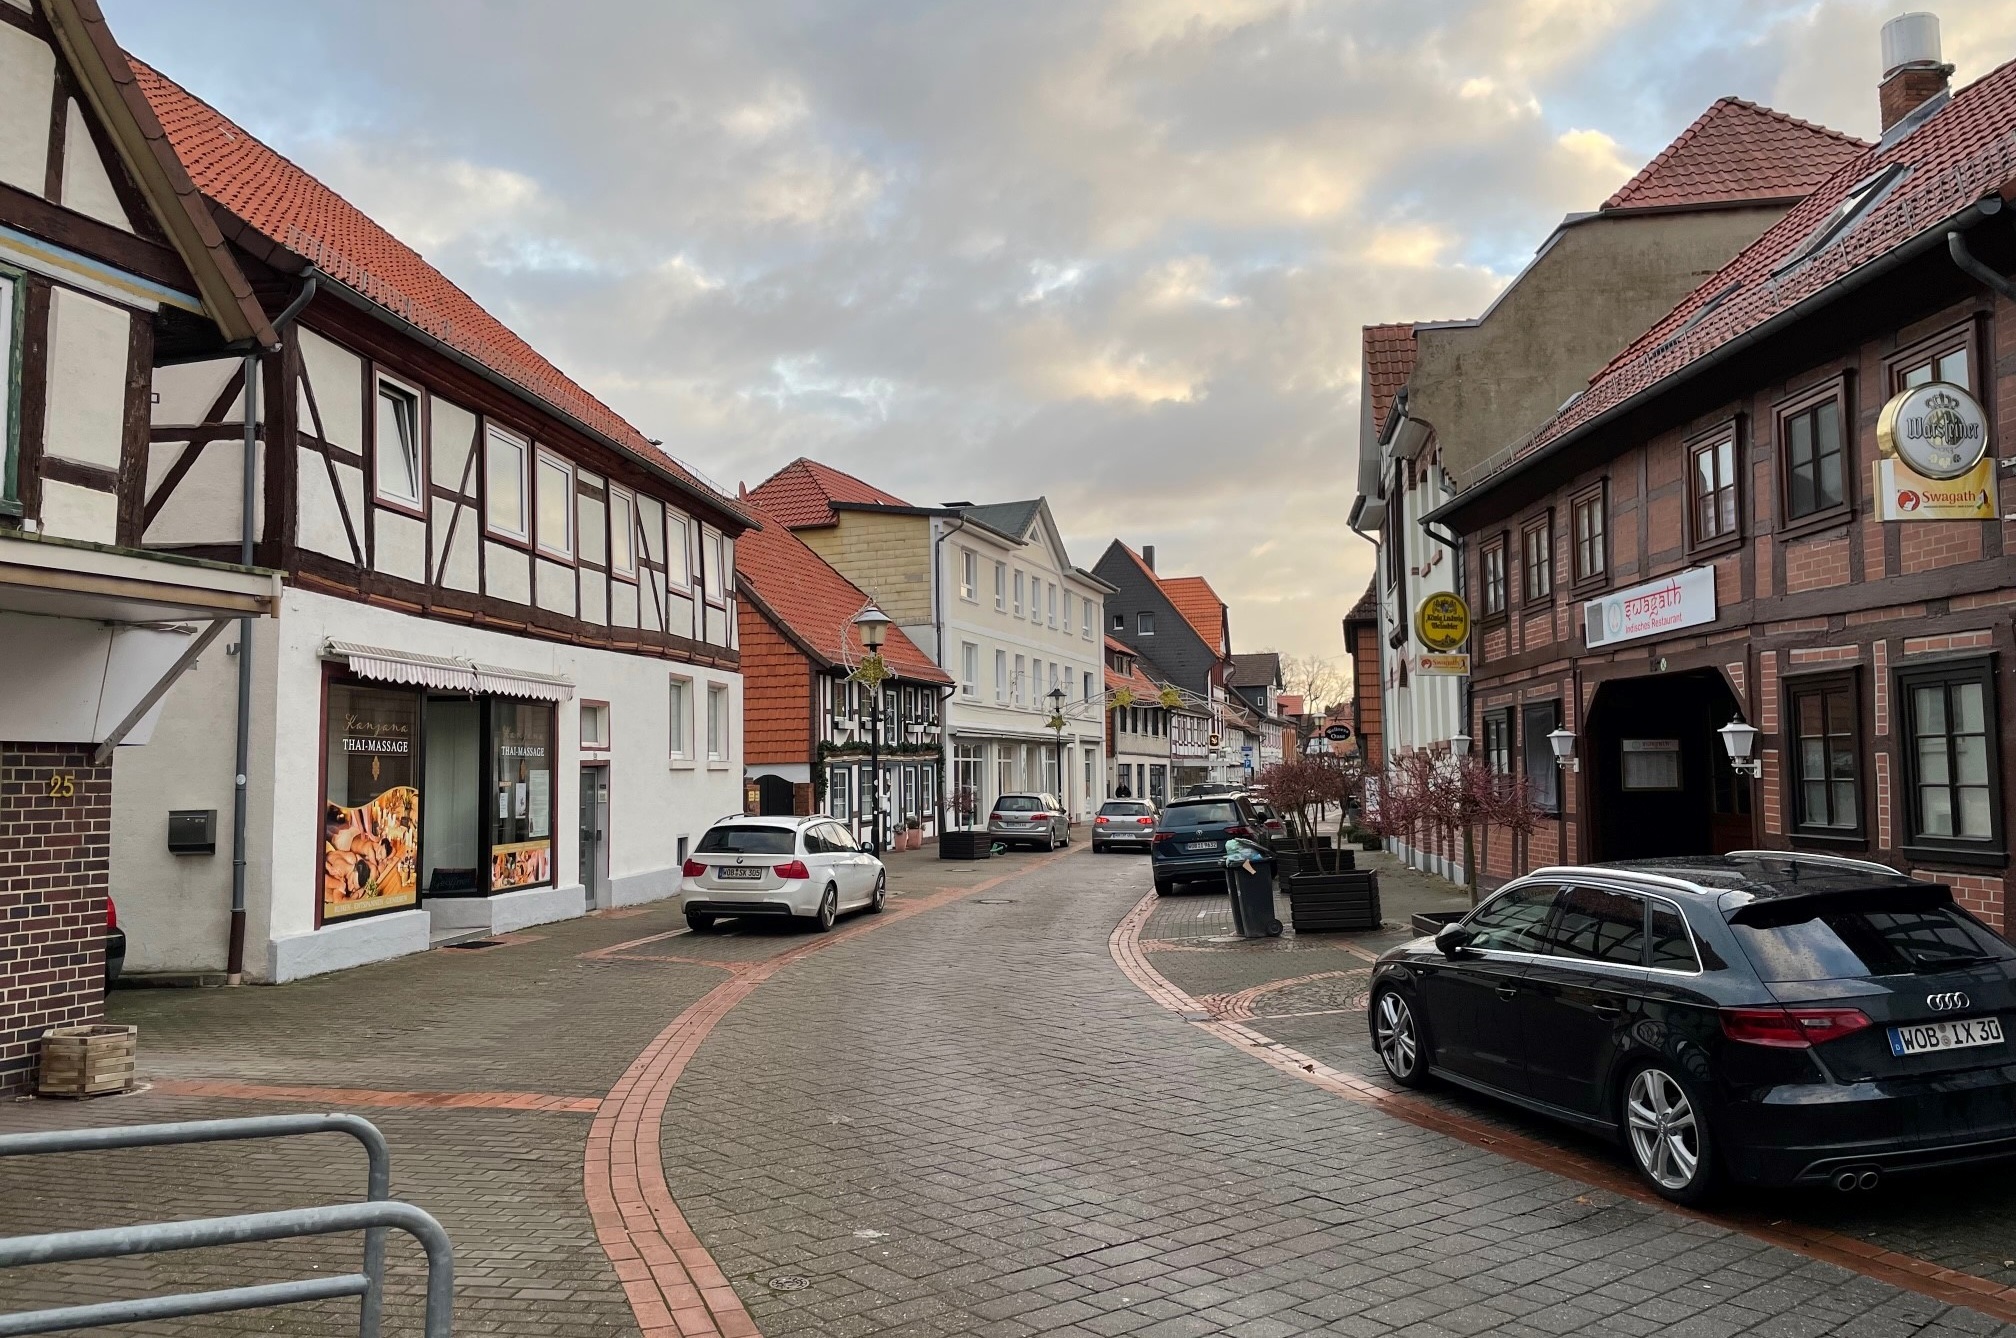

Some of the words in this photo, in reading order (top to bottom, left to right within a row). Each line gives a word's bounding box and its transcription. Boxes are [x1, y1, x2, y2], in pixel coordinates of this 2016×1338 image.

[1906, 413, 1979, 444] Warsteiner
[1922, 490, 1976, 503] Swagath
[1625, 620, 1653, 634] Indisches
[1651, 613, 1683, 629] Restaurant
[343, 713, 408, 737] Kanjana
[343, 739, 409, 752] THAI-MASSAGE
[501, 746, 545, 757] THAI-MASSAGE
[50, 775, 75, 797] 25
[1900, 1026, 1940, 1051] WOB
[1952, 1022, 1977, 1045] IX
[1976, 1020, 2001, 1041] 30
